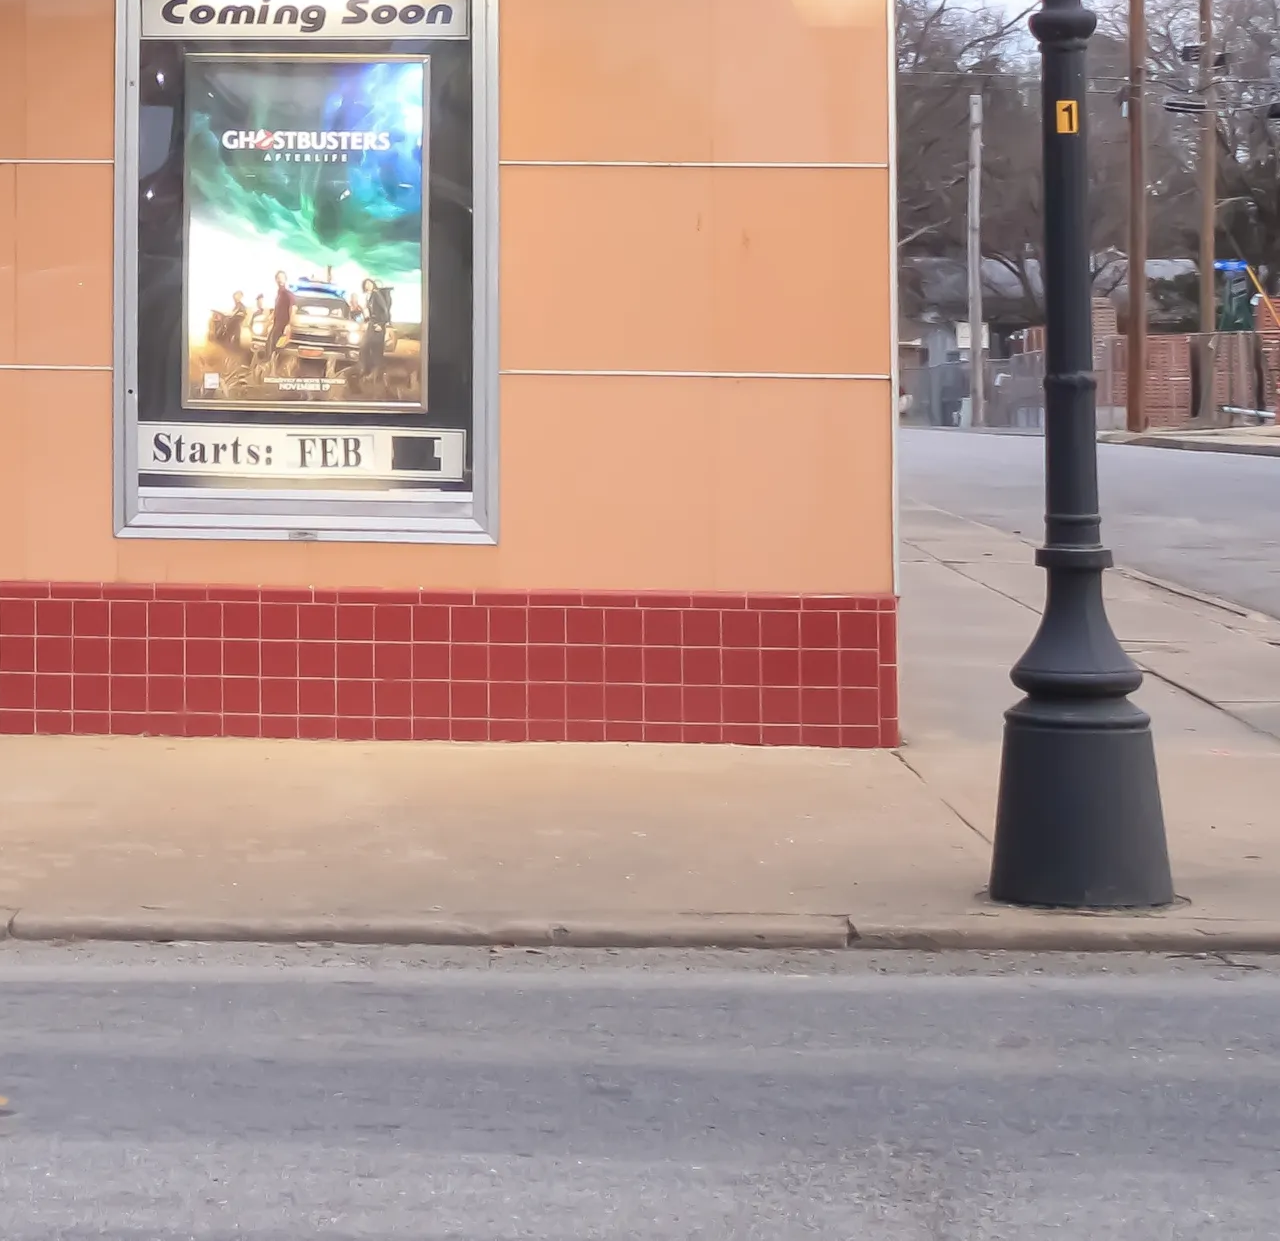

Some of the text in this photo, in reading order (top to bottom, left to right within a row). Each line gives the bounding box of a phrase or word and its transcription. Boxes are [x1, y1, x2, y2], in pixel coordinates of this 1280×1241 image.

[1061, 103, 1074, 132] 1
[222, 129, 391, 151] GHOSTBUSTERS
[263, 153, 349, 163] AFTERLIFE
[151, 432, 363, 468] Starts: FEB
